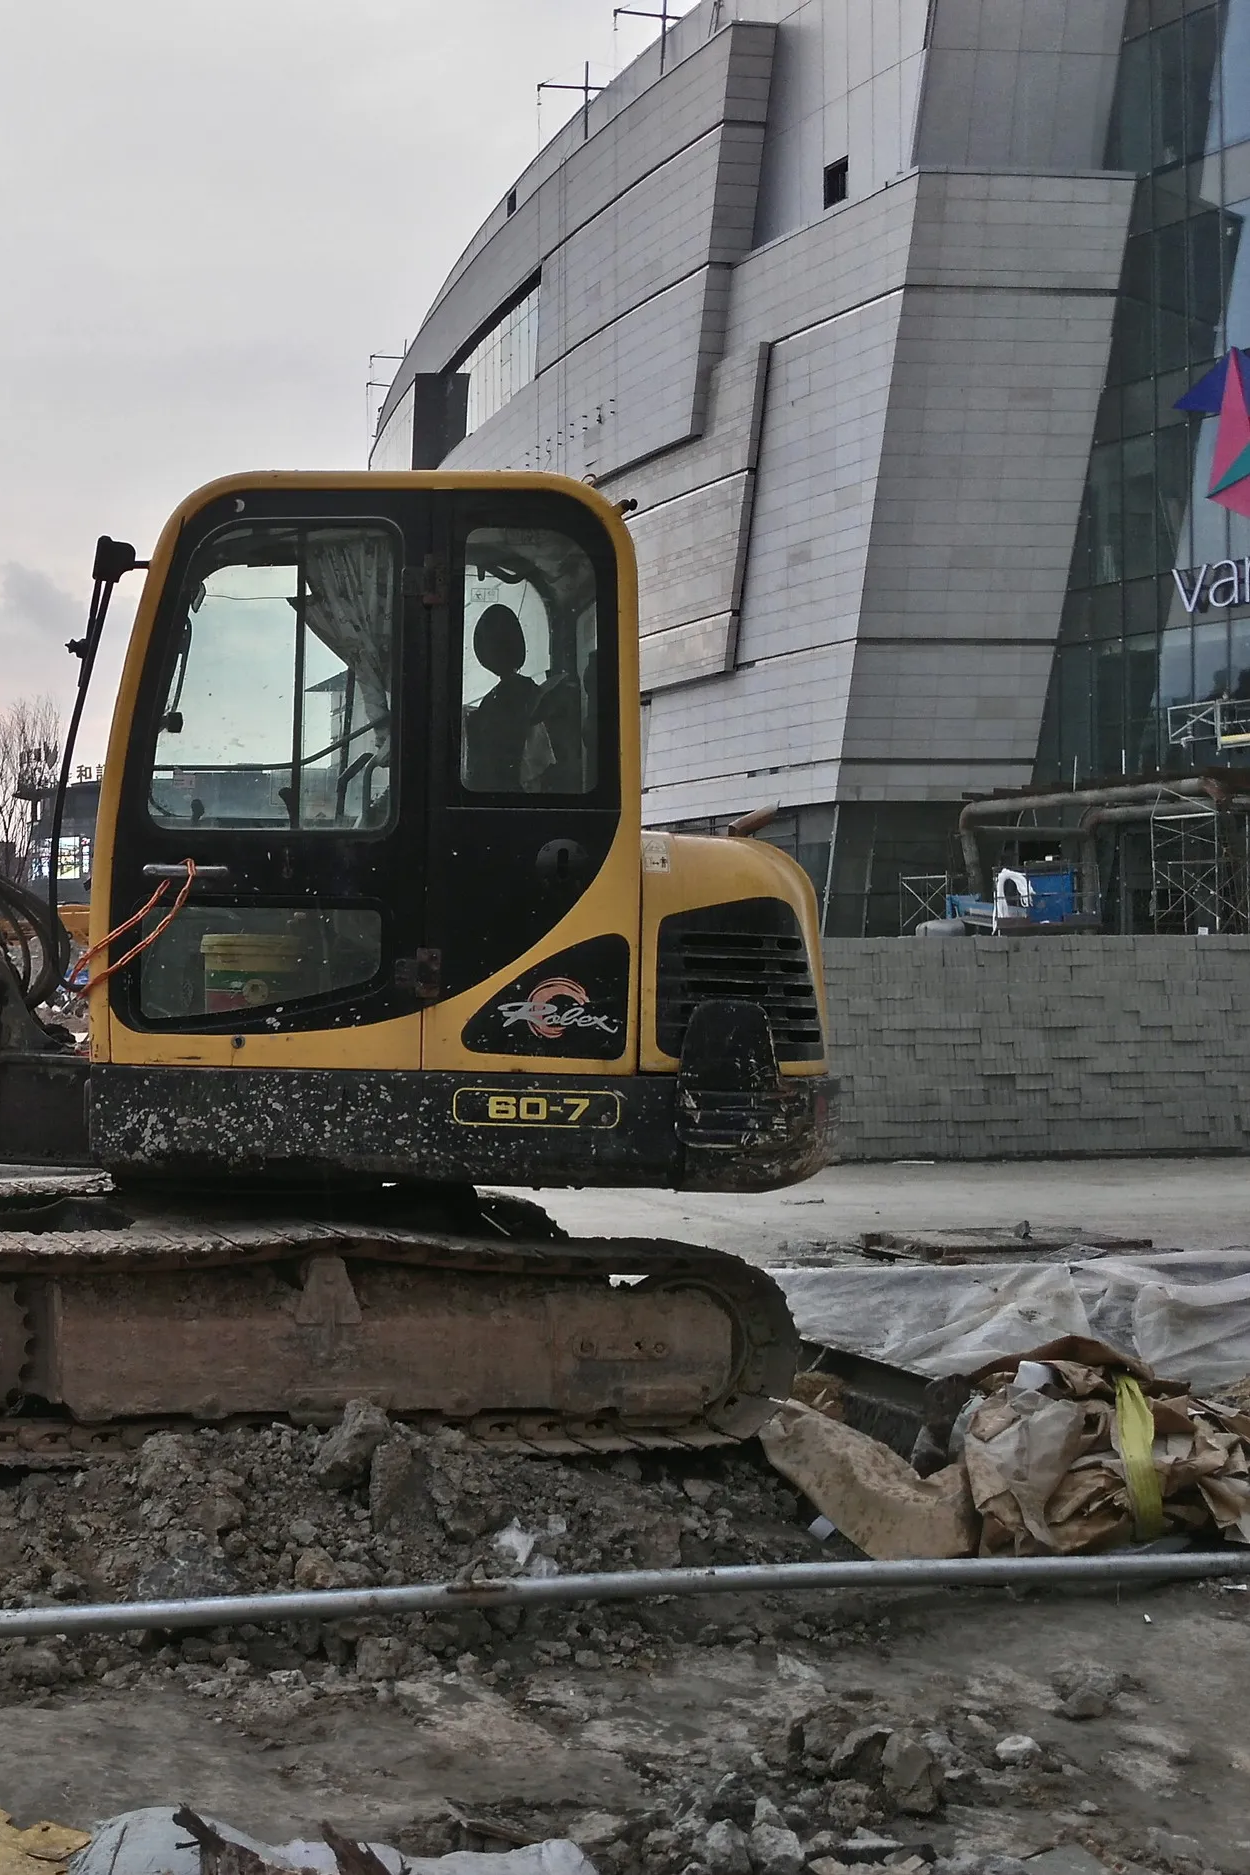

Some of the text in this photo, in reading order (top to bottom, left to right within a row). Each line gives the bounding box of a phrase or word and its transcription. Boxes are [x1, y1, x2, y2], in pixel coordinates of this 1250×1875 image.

[1171, 555, 1250, 613] va
[498, 1001, 618, 1034] Robex
[488, 1096, 590, 1121] 60-7
